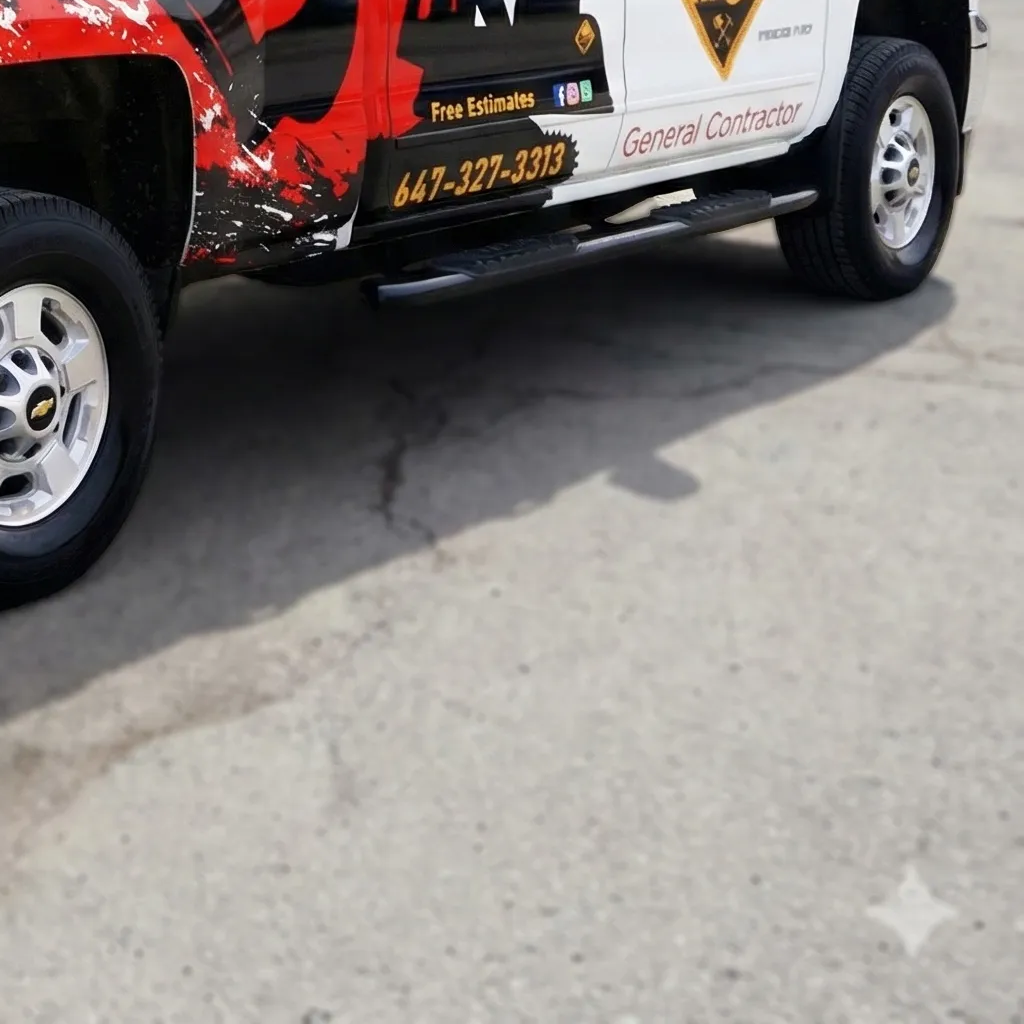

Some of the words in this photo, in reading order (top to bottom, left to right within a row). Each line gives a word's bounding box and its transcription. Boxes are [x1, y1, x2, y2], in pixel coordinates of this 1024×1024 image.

[431, 101, 464, 123] Free
[467, 91, 536, 118] Estimates
[623, 113, 703, 158] General
[706, 100, 803, 141] Contractor
[392, 141, 566, 208] 647-327-3313
